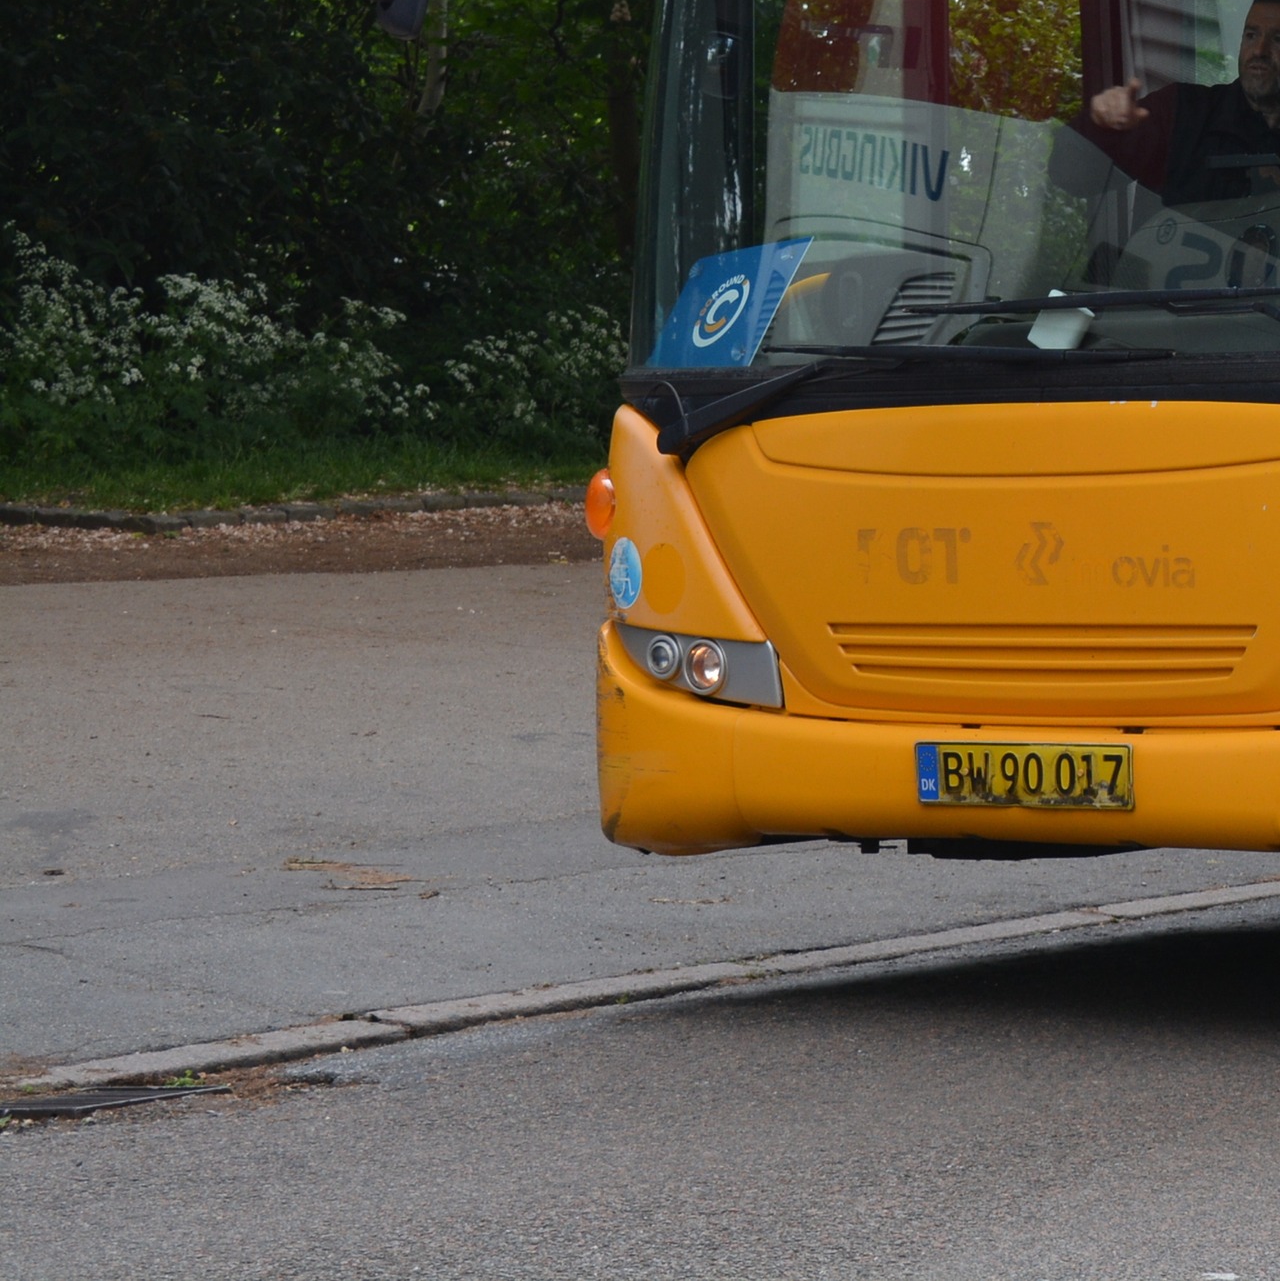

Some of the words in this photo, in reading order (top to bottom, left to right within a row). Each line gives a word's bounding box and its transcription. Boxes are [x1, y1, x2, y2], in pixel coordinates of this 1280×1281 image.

[921, 778, 936, 792] DK
[1000, 752, 1044, 795] 90
[1055, 753, 1124, 796] 017
